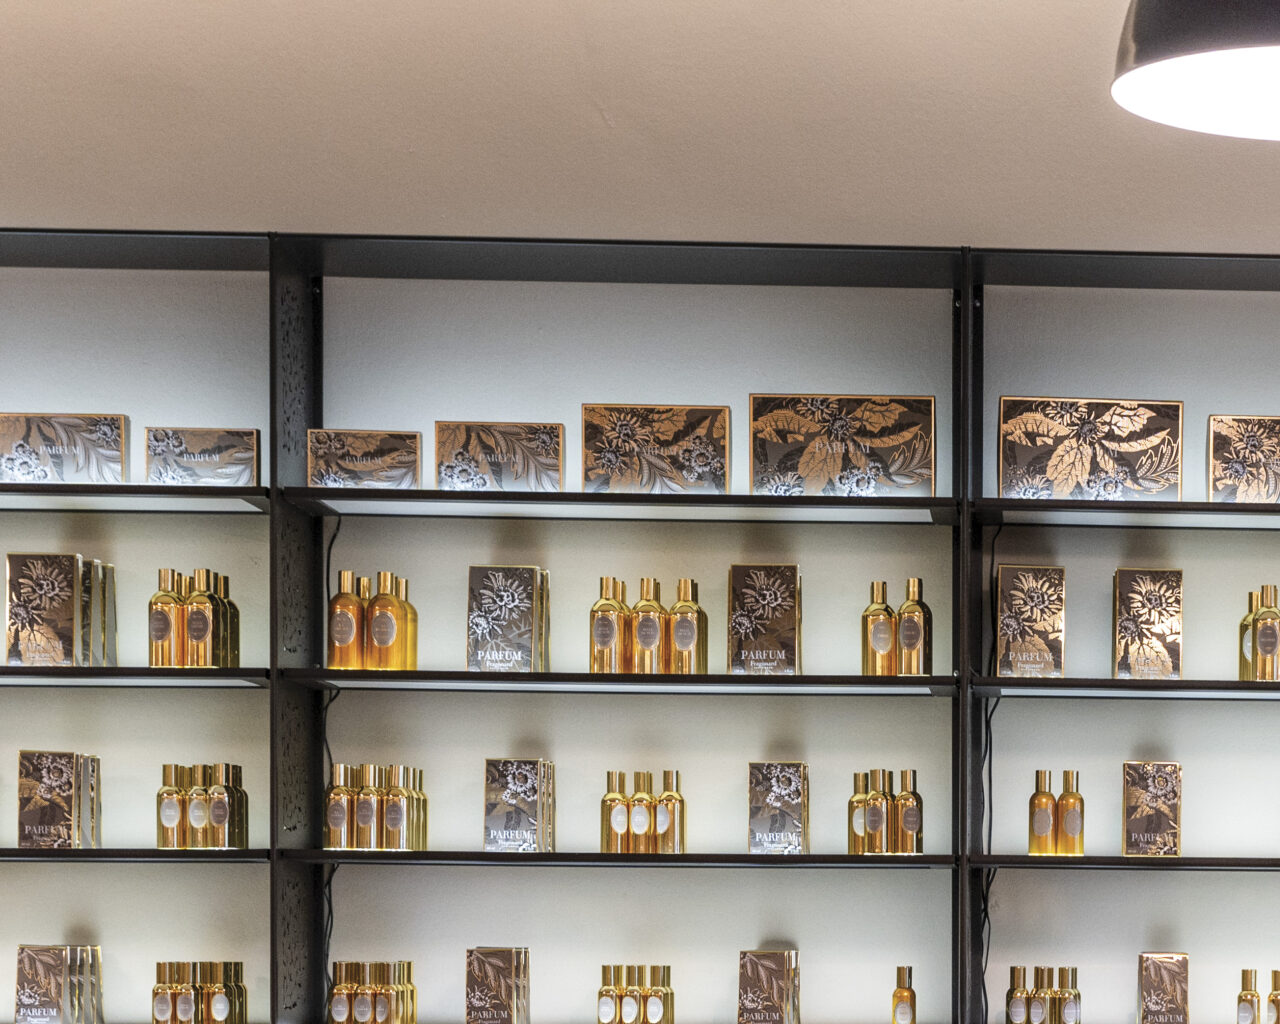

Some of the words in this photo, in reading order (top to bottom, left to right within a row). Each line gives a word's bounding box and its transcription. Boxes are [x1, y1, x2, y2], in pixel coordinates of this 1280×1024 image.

[40, 445, 81, 455] PARFUM
[816, 441, 870, 453] PARFUM
[183, 453, 220, 461] PARFUM
[346, 456, 382, 464] PARFUM
[478, 651, 522, 661] PARFUM
[741, 650, 786, 660] PARFUM
[1010, 652, 1054, 662] PARFUM
[24, 825, 67, 836] PARFUM
[491, 829, 531, 840] PARFUM
[755, 832, 796, 843] PARFUM
[1132, 832, 1172, 842] PARFUM
[20, 1007, 57, 1017] PARFUM
[471, 1010, 507, 1019] PARFUM
[744, 1012, 780, 1021] PARFUM
[1148, 1014, 1183, 1023] PARFUM
